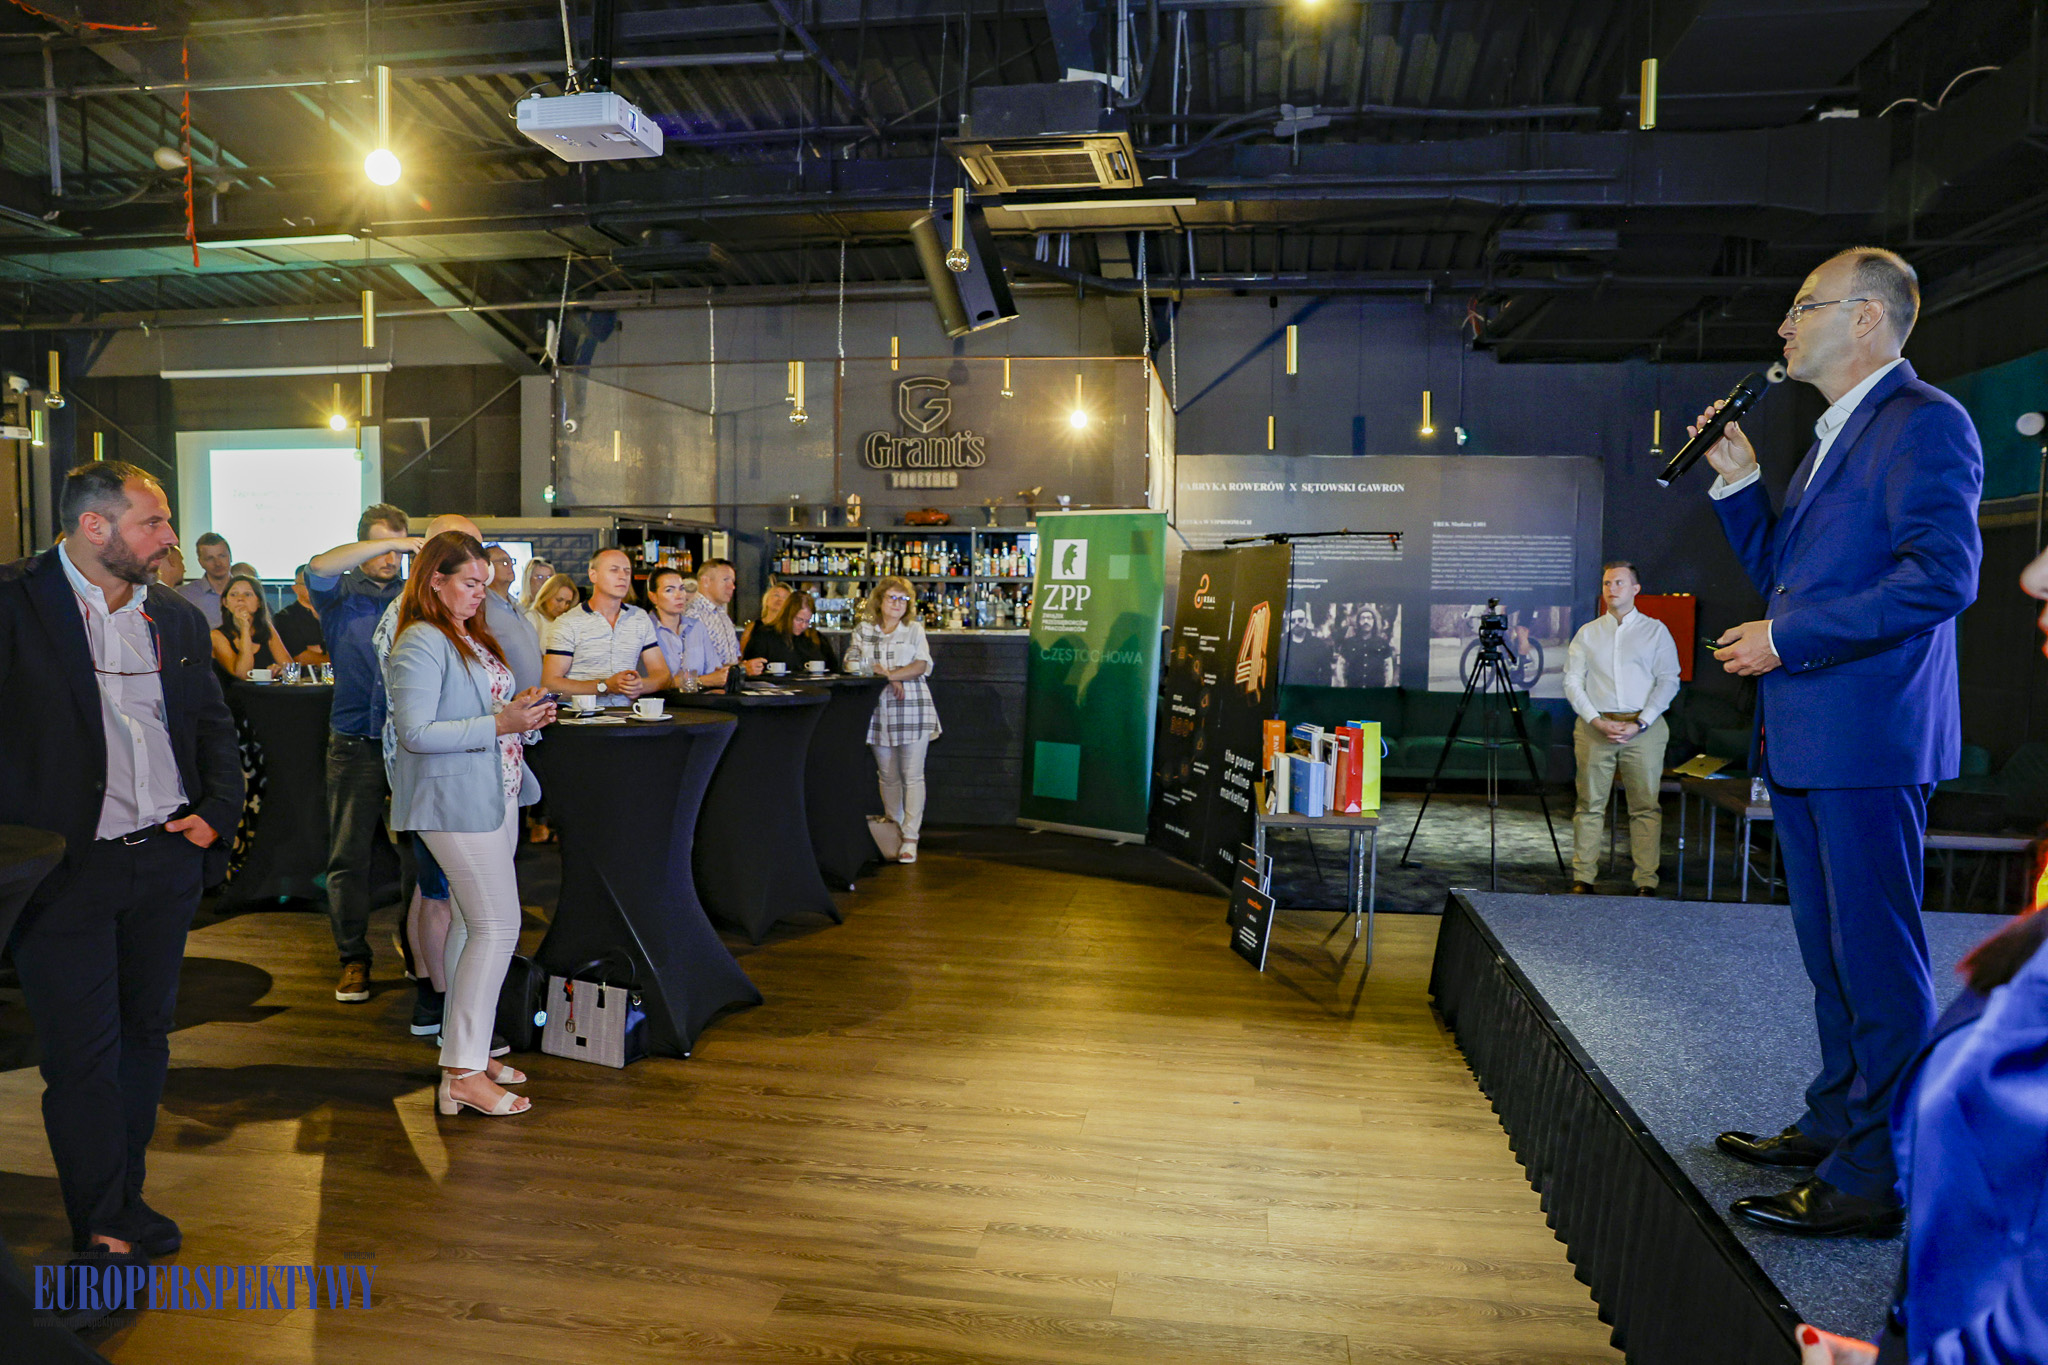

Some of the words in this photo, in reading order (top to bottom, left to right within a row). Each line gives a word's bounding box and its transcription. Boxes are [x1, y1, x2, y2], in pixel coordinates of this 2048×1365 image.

[864, 430, 986, 469] Grant's
[891, 471, 958, 488] TOGETHER
[1179, 482, 1228, 492] FABRYKA
[1229, 481, 1285, 492] ROWERÓW
[1289, 482, 1298, 492] X
[1301, 483, 1356, 494] SĘTOWSKI
[1358, 483, 1406, 493] GAWRON
[1042, 584, 1091, 611] ZPP
[1040, 648, 1143, 664] CZĘSTOCHOWA
[1225, 749, 1235, 764] the
[1235, 755, 1255, 772] power
[1224, 768, 1232, 782] of
[1231, 773, 1250, 790] online
[1220, 787, 1249, 813] marketing
